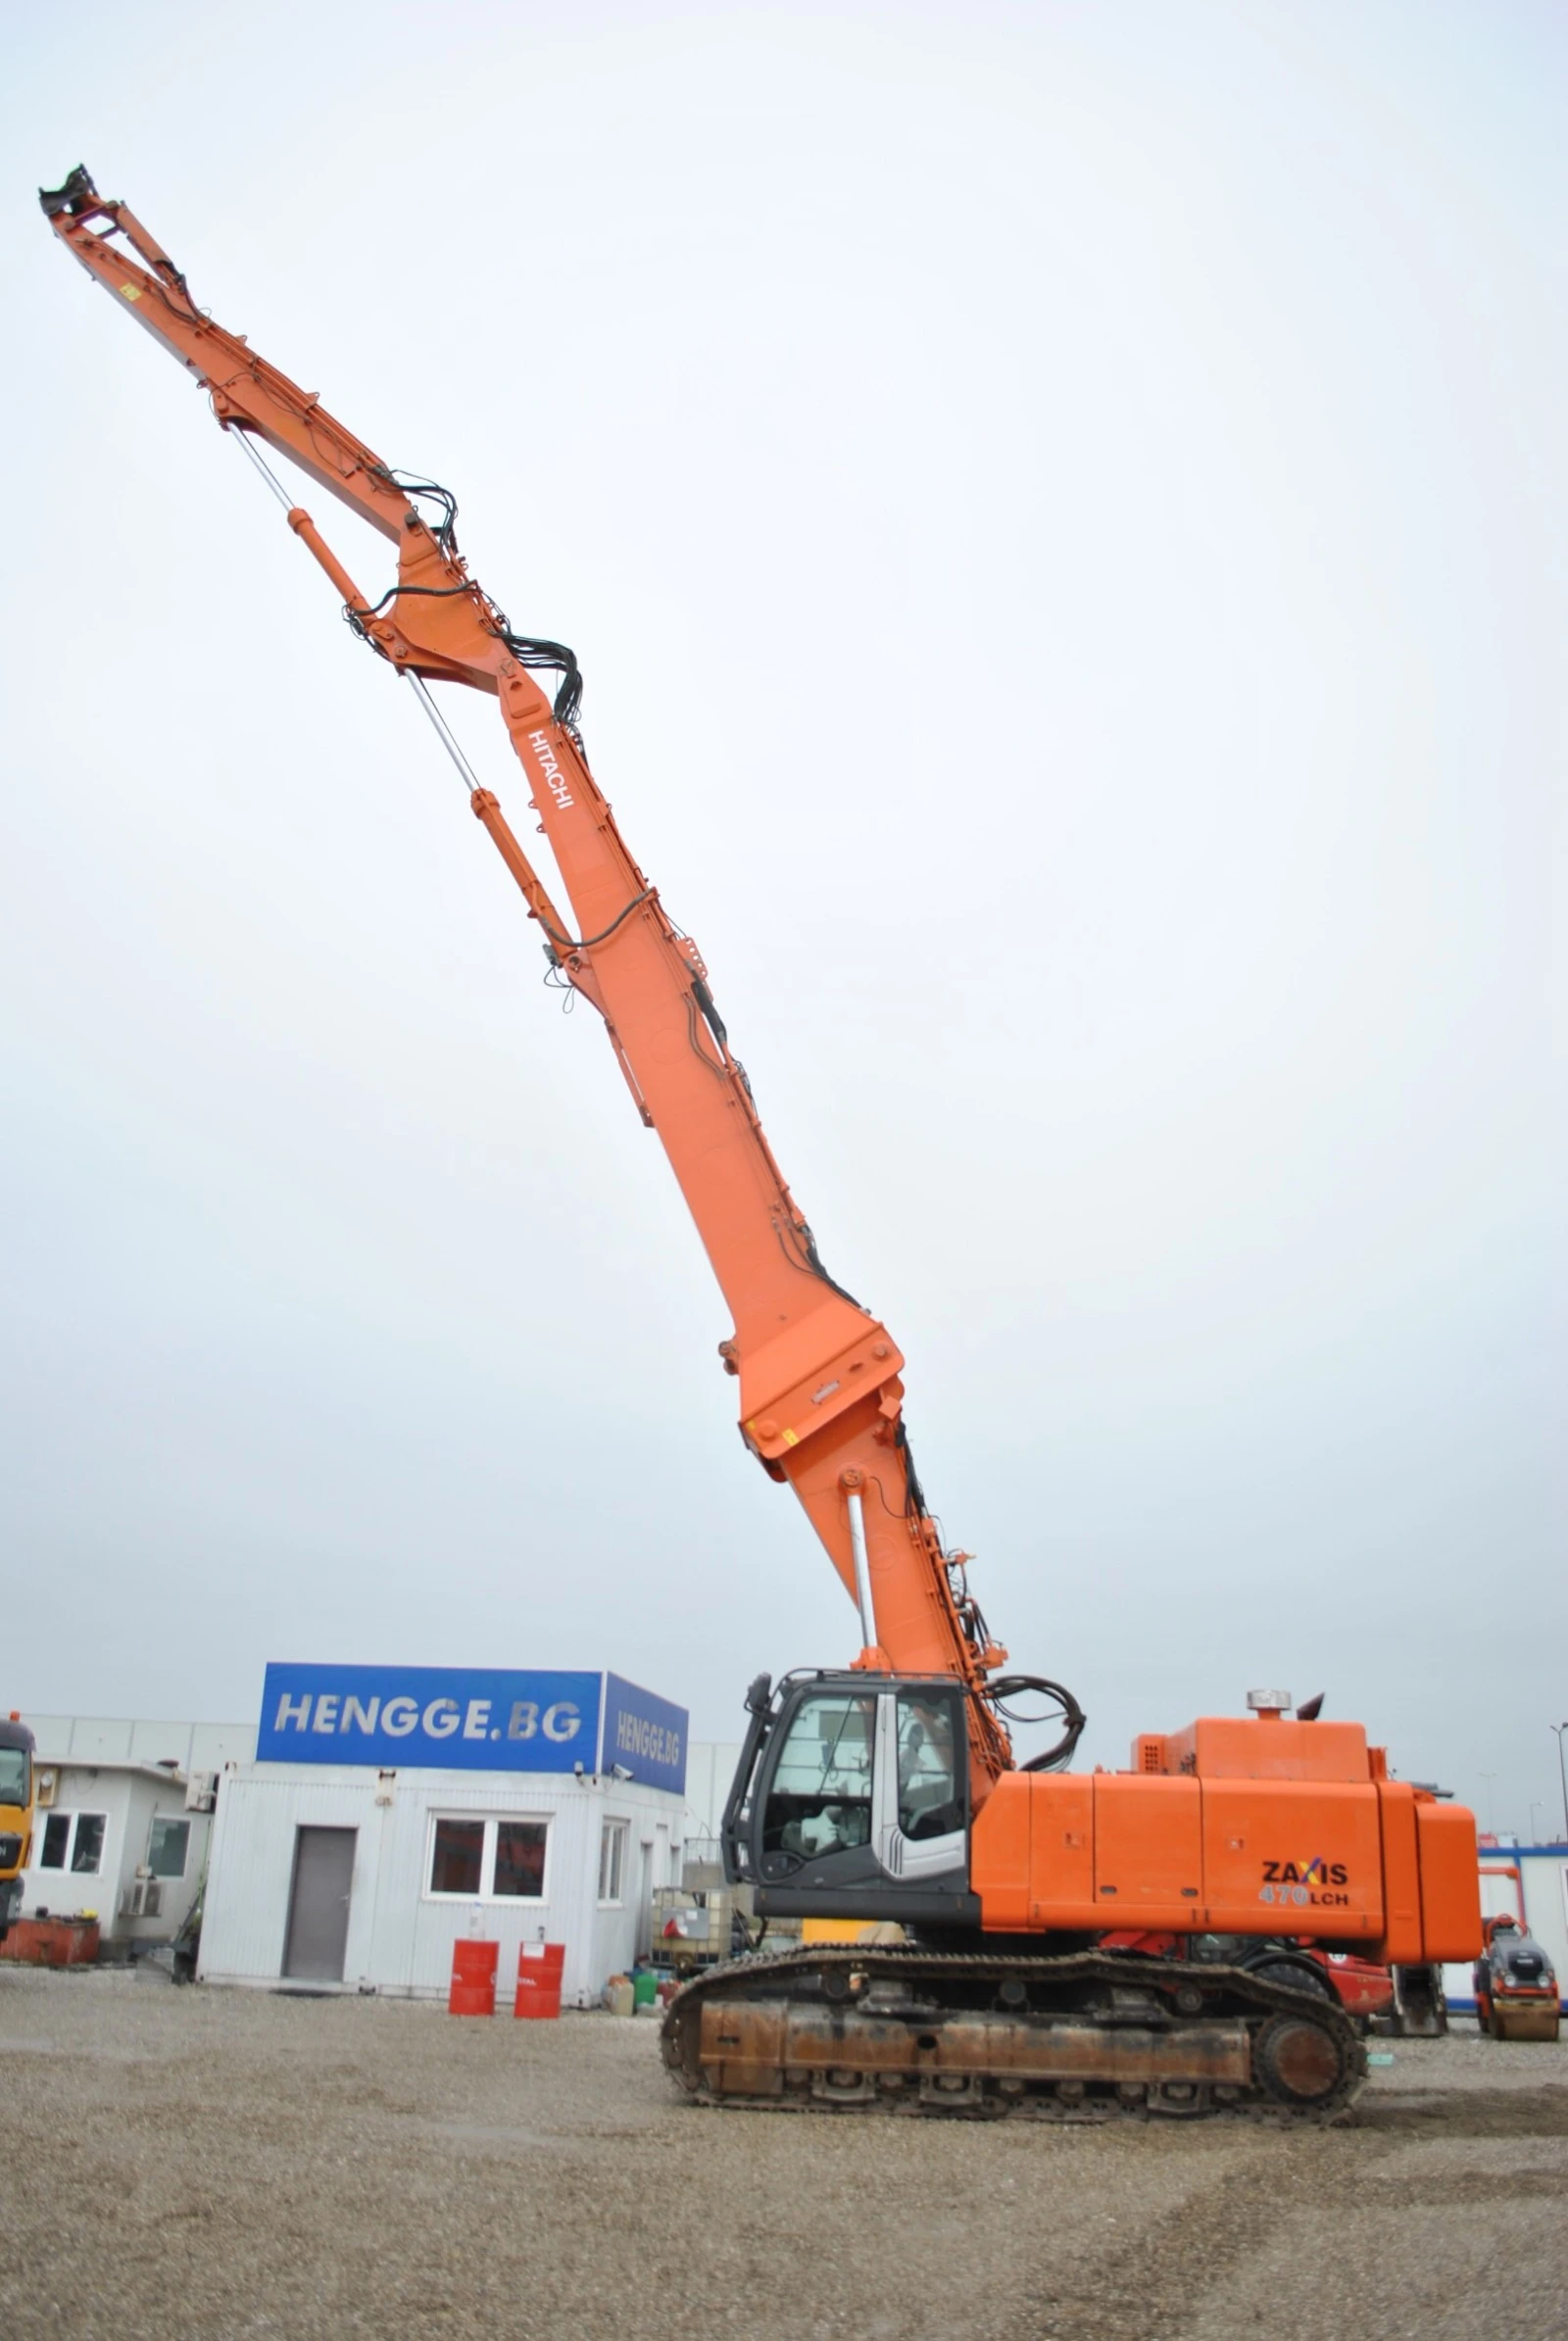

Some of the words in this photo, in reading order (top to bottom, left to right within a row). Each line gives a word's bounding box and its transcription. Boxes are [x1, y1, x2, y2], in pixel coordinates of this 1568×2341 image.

[528, 729, 575, 809] HITACHI
[274, 1692, 582, 1742] HENGGE.BG
[616, 1710, 680, 1767] HENGGE.BG
[1262, 1857, 1348, 1885] ZAXIS
